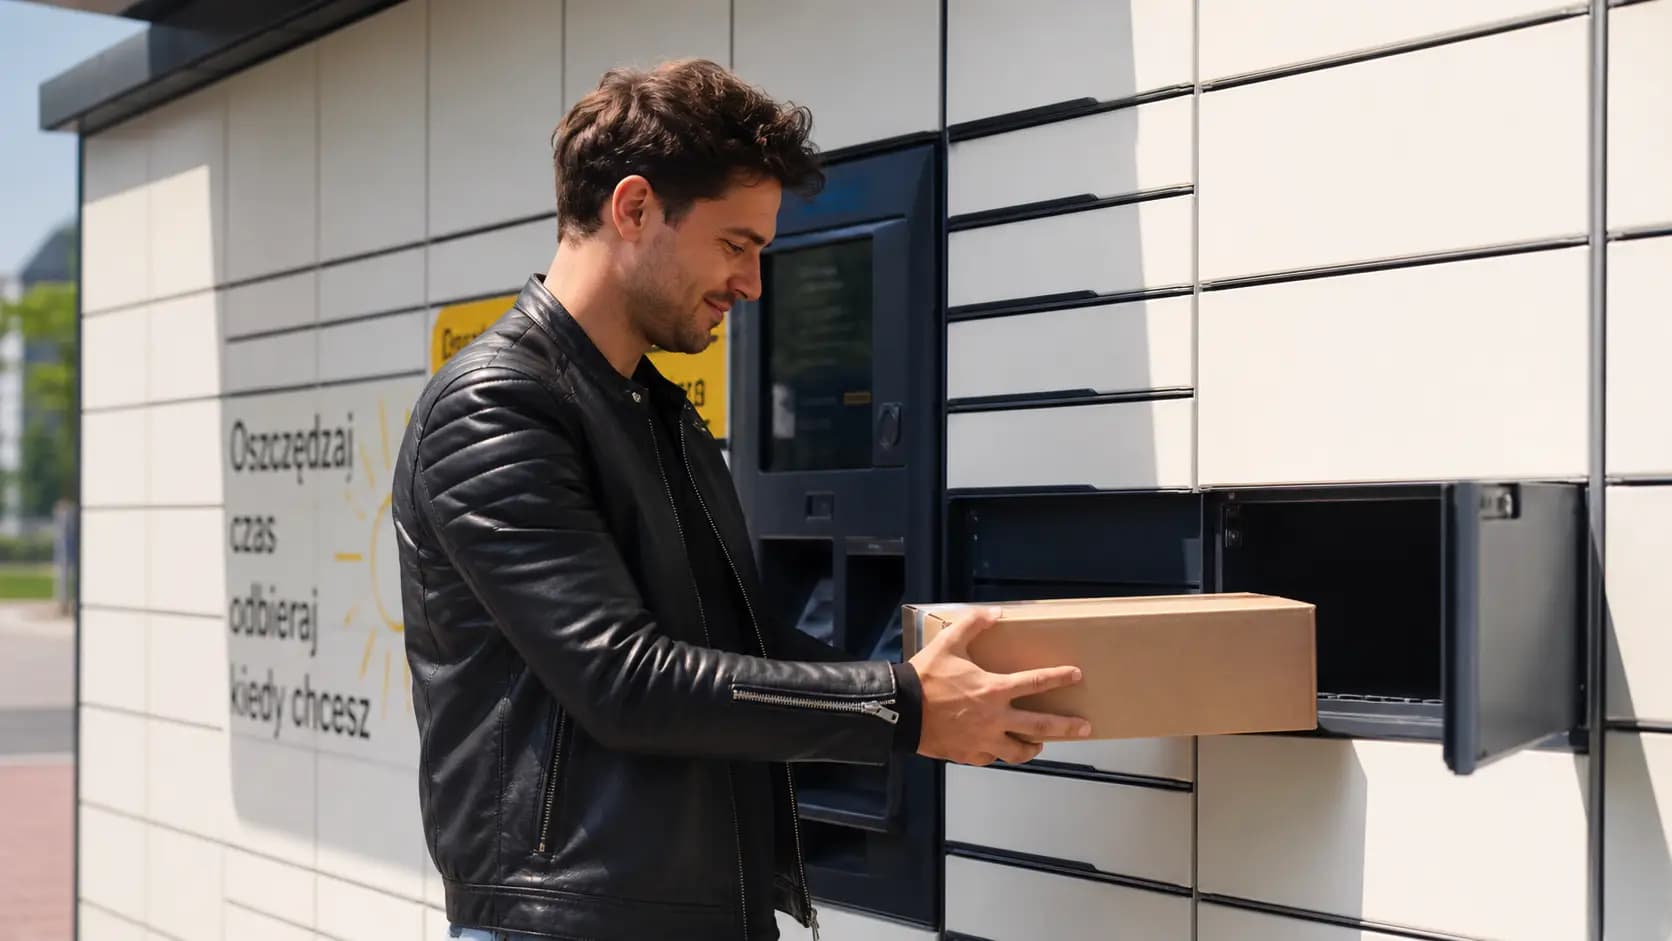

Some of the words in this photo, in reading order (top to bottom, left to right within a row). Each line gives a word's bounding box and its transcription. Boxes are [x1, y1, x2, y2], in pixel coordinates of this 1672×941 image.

[230, 412, 354, 483] Oszczędzaj
[230, 515, 277, 554] czas
[230, 585, 319, 657] odbieraj
[230, 664, 286, 739] kiedy
[291, 674, 371, 739] chcesz
